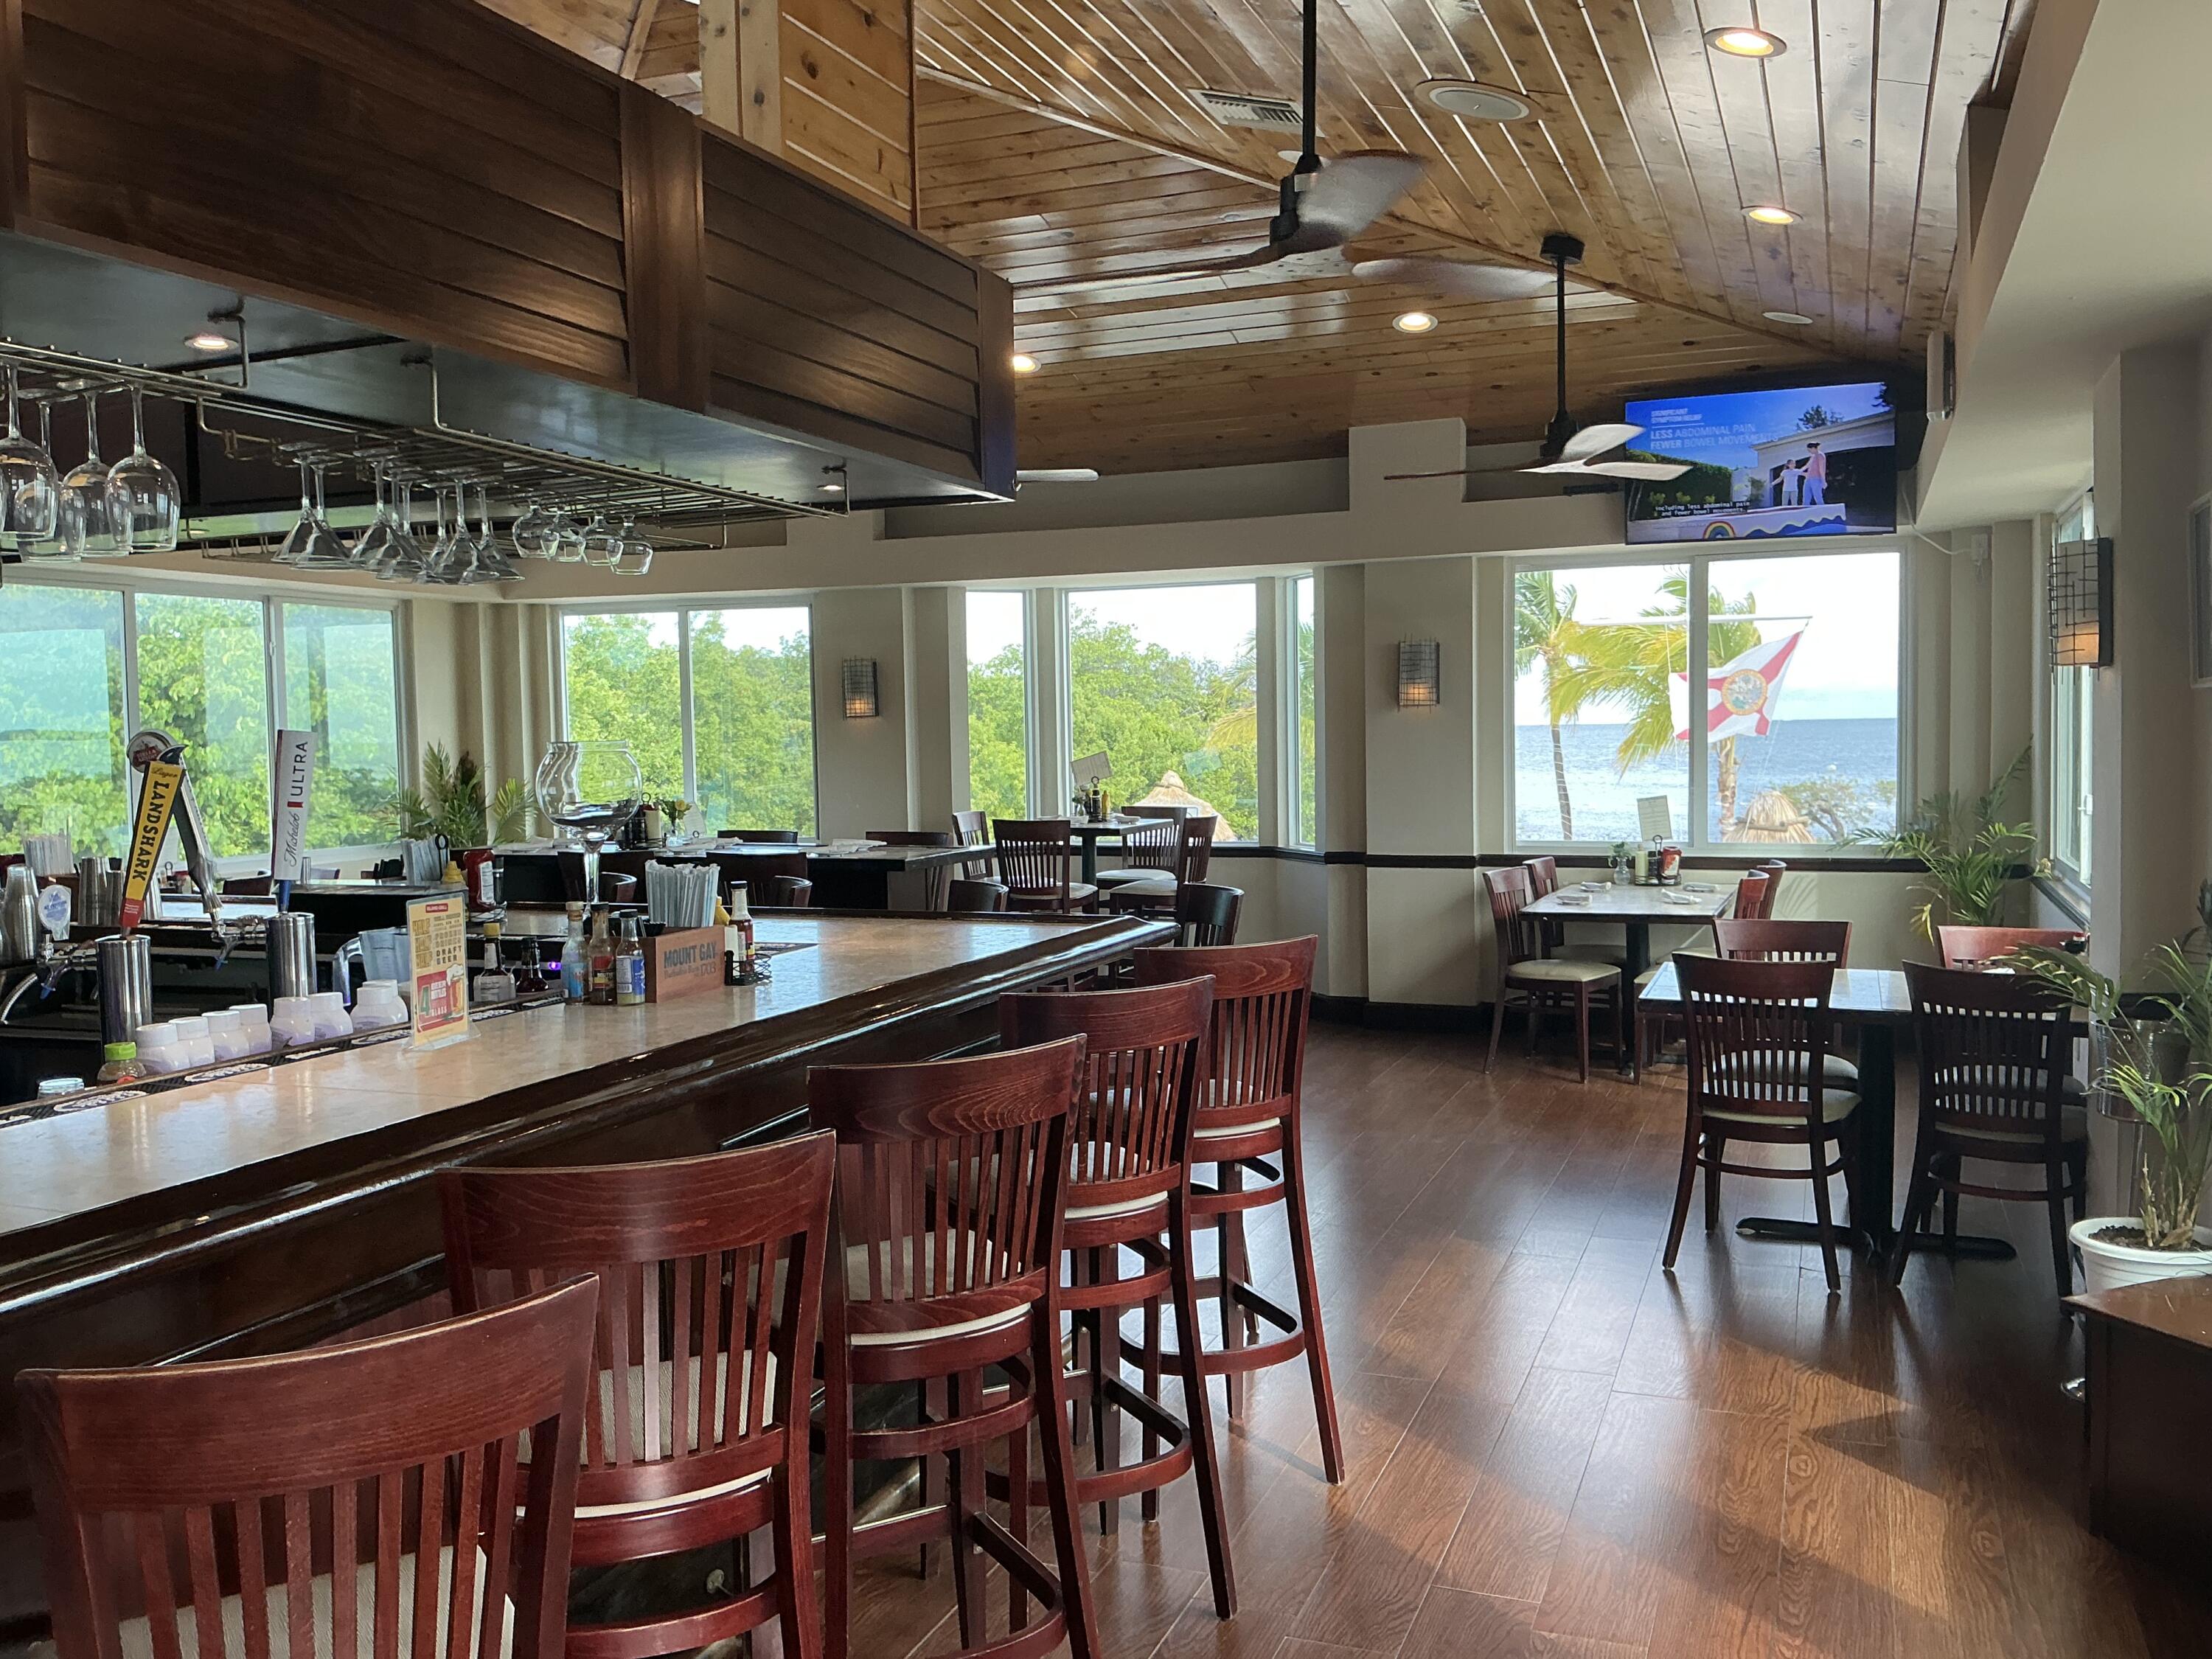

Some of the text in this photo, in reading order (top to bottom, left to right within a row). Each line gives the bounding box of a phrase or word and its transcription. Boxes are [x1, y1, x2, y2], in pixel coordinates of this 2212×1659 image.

[1651, 423, 1756, 439] LESS ABDOMINAL PAIN
[1651, 440, 1682, 451] FEWER
[1683, 437, 1717, 448] BOWEL
[284, 741, 308, 867] Michelob ULTRA
[132, 781, 170, 881] LANDSHARK
[437, 945, 462, 957] DRAFT
[664, 942, 716, 969] MOUNT GAY
[437, 954, 457, 965] BEER
